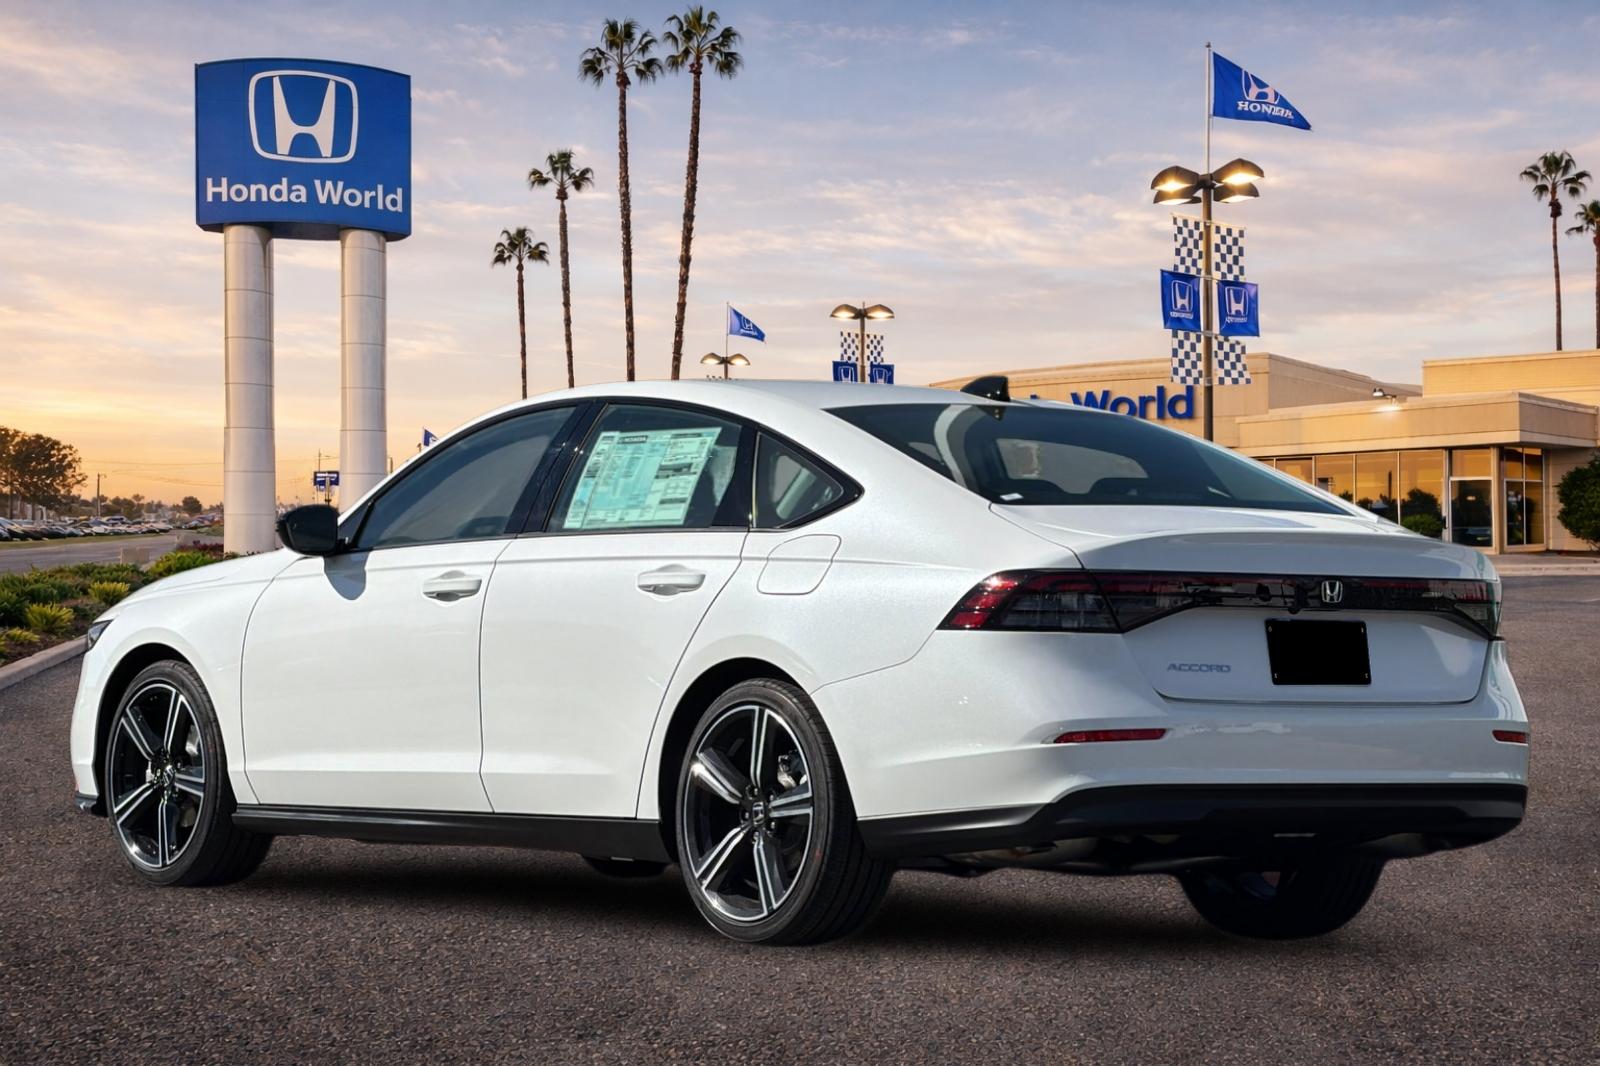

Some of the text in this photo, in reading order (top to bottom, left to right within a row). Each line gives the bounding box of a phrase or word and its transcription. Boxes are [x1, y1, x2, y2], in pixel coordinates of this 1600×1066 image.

[206, 177, 403, 213] Honda World
[1071, 385, 1195, 420] World
[1167, 663, 1231, 673] ACCORD
